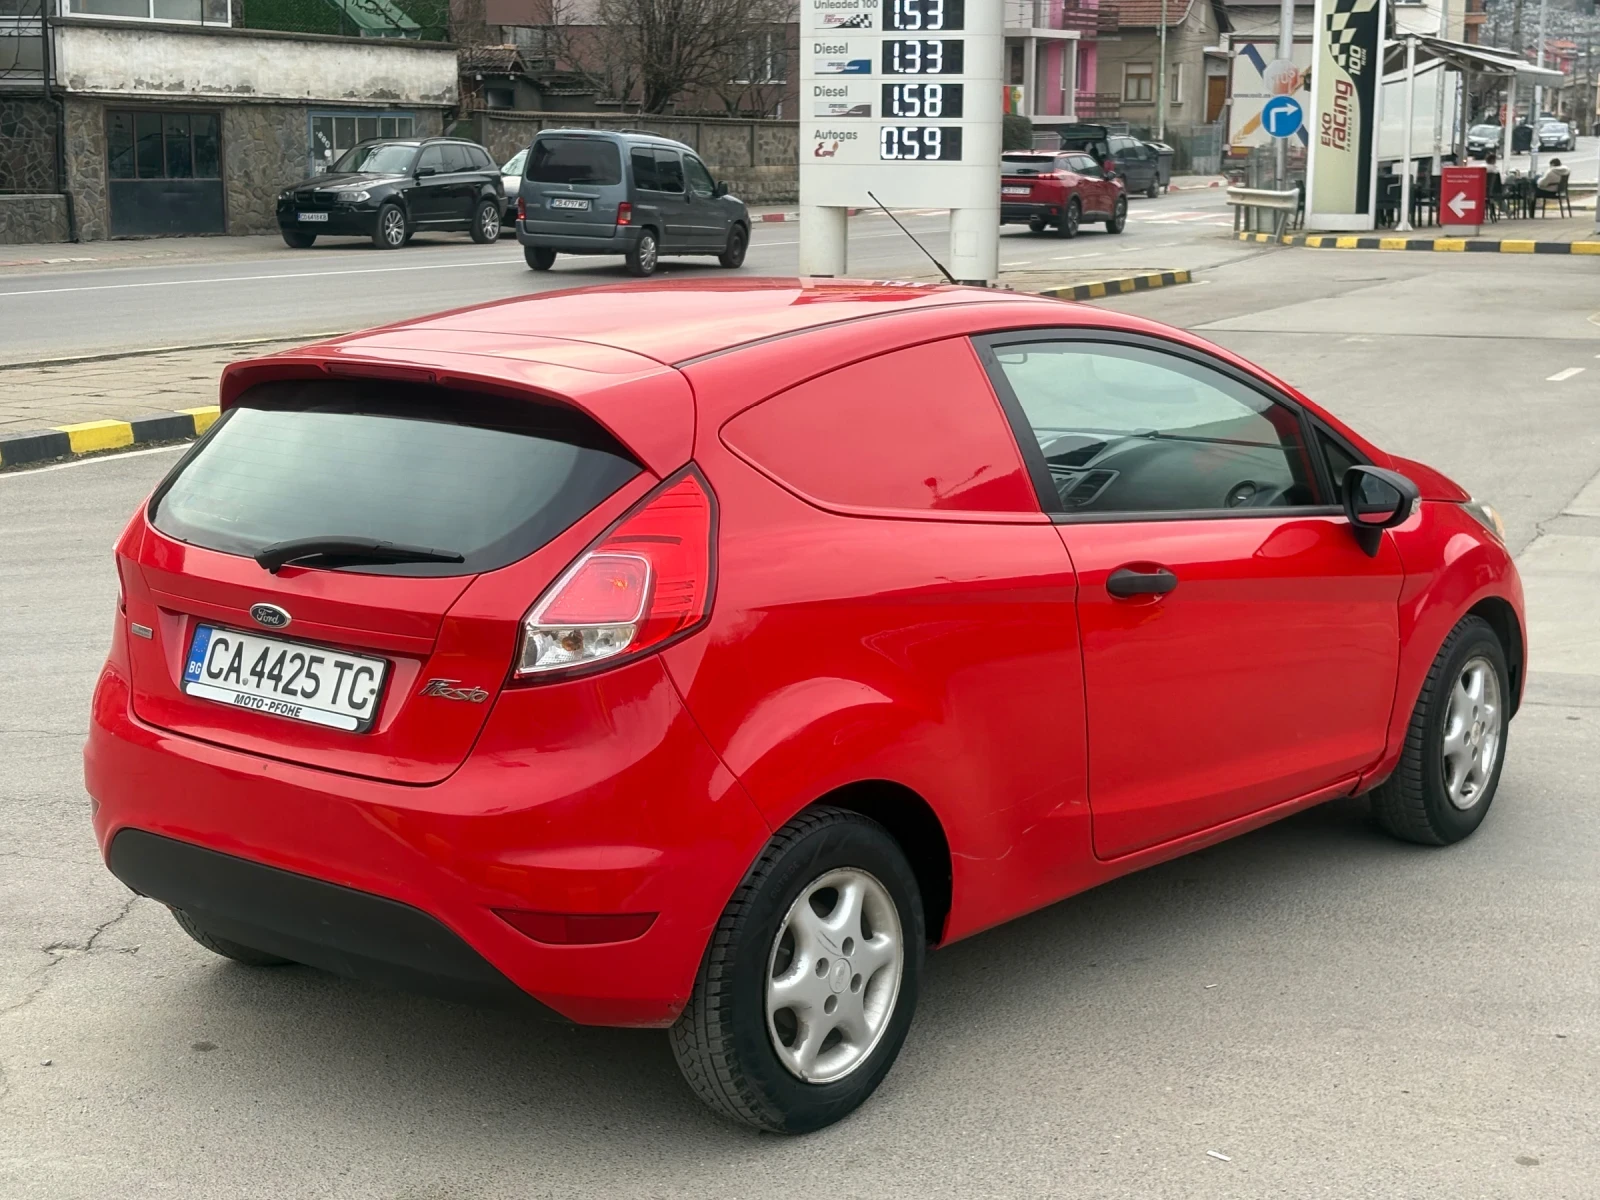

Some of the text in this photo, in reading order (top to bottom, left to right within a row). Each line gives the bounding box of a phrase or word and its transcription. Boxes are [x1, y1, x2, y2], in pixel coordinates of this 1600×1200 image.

[814, 0, 879, 9] Unleaded 100
[814, 42, 848, 54] Diesel
[1348, 44, 1361, 76] 100
[814, 85, 848, 97] Diesel
[1331, 79, 1354, 151] racing
[814, 129, 858, 142] Autogas
[1320, 112, 1332, 147] EKO
[256, 608, 280, 625] Ford
[188, 661, 202, 674] BG
[206, 637, 375, 711] CA 4425 TC
[418, 677, 489, 703] Fiesta
[234, 693, 303, 718] MOTO-PFOHE
